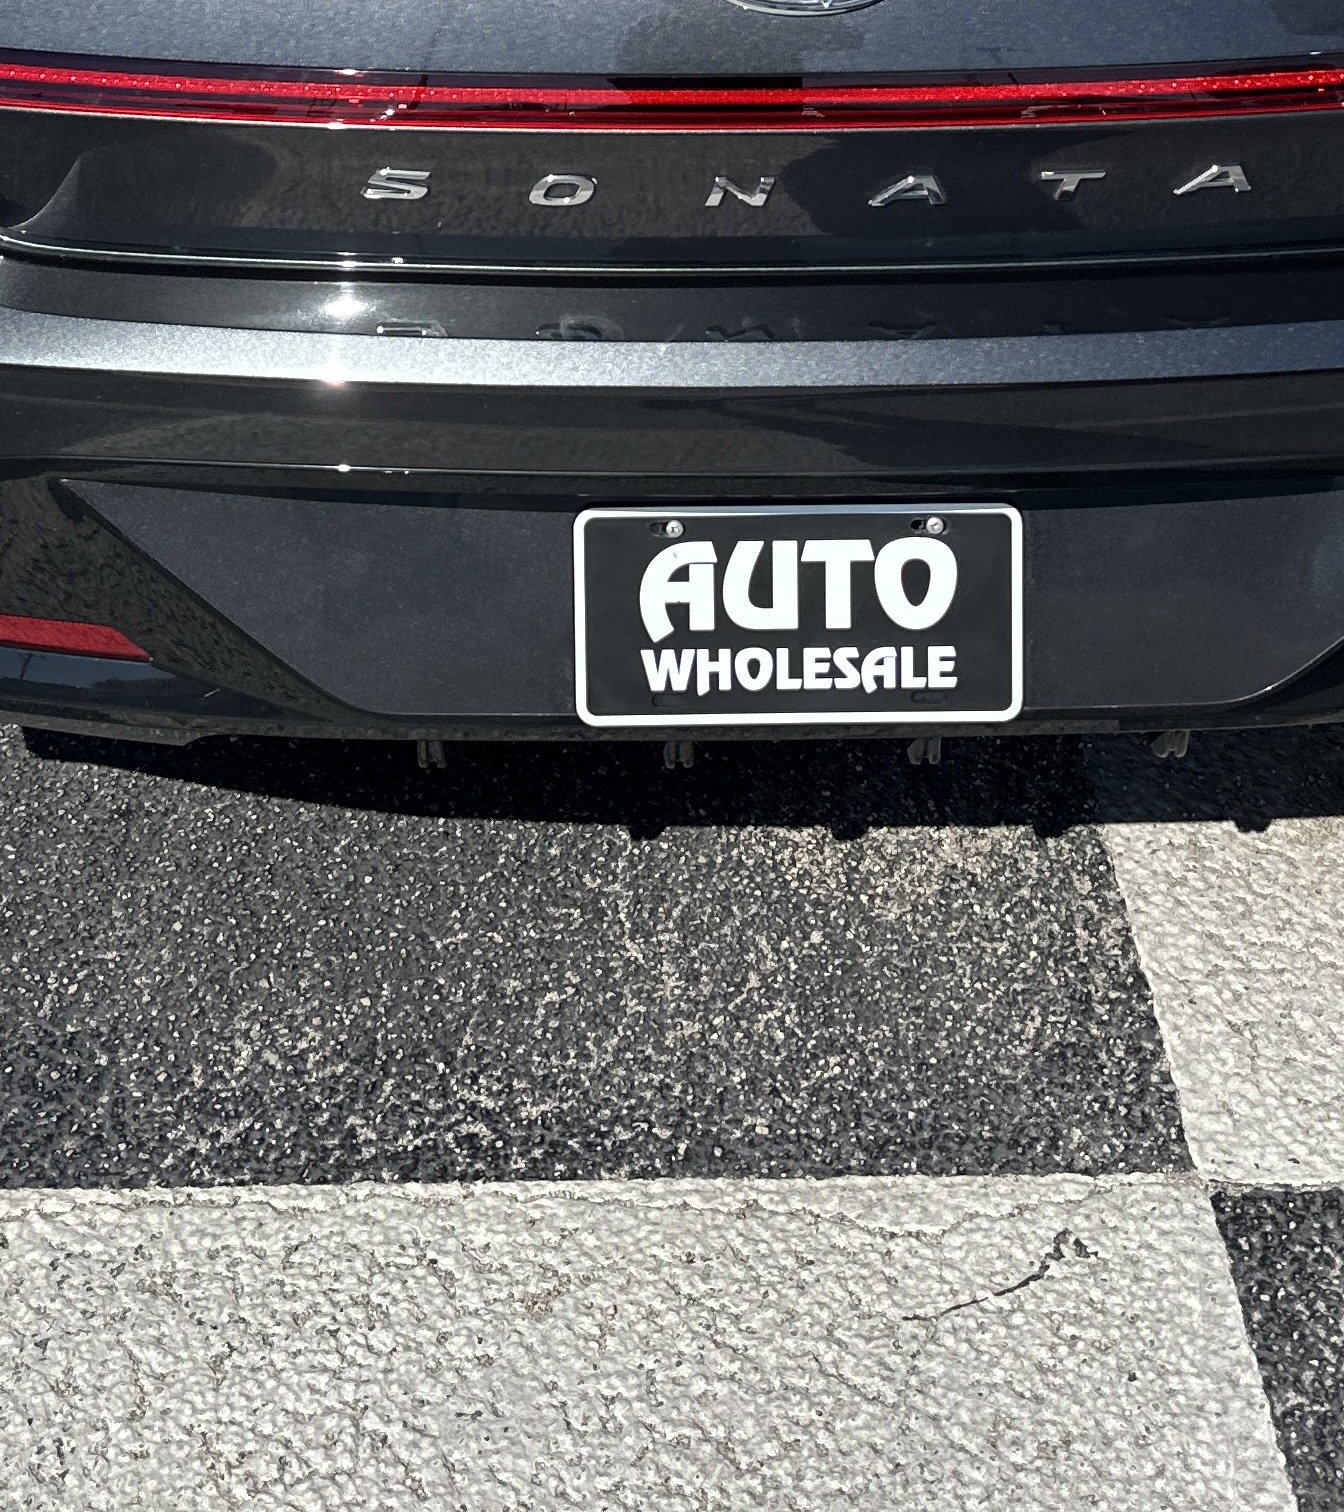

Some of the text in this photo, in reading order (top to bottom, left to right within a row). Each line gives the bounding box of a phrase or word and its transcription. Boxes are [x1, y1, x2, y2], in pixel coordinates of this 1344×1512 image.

[360, 162, 1253, 208] SONATA
[639, 536, 958, 644] AUTO
[640, 644, 958, 696] WHOLESALE
